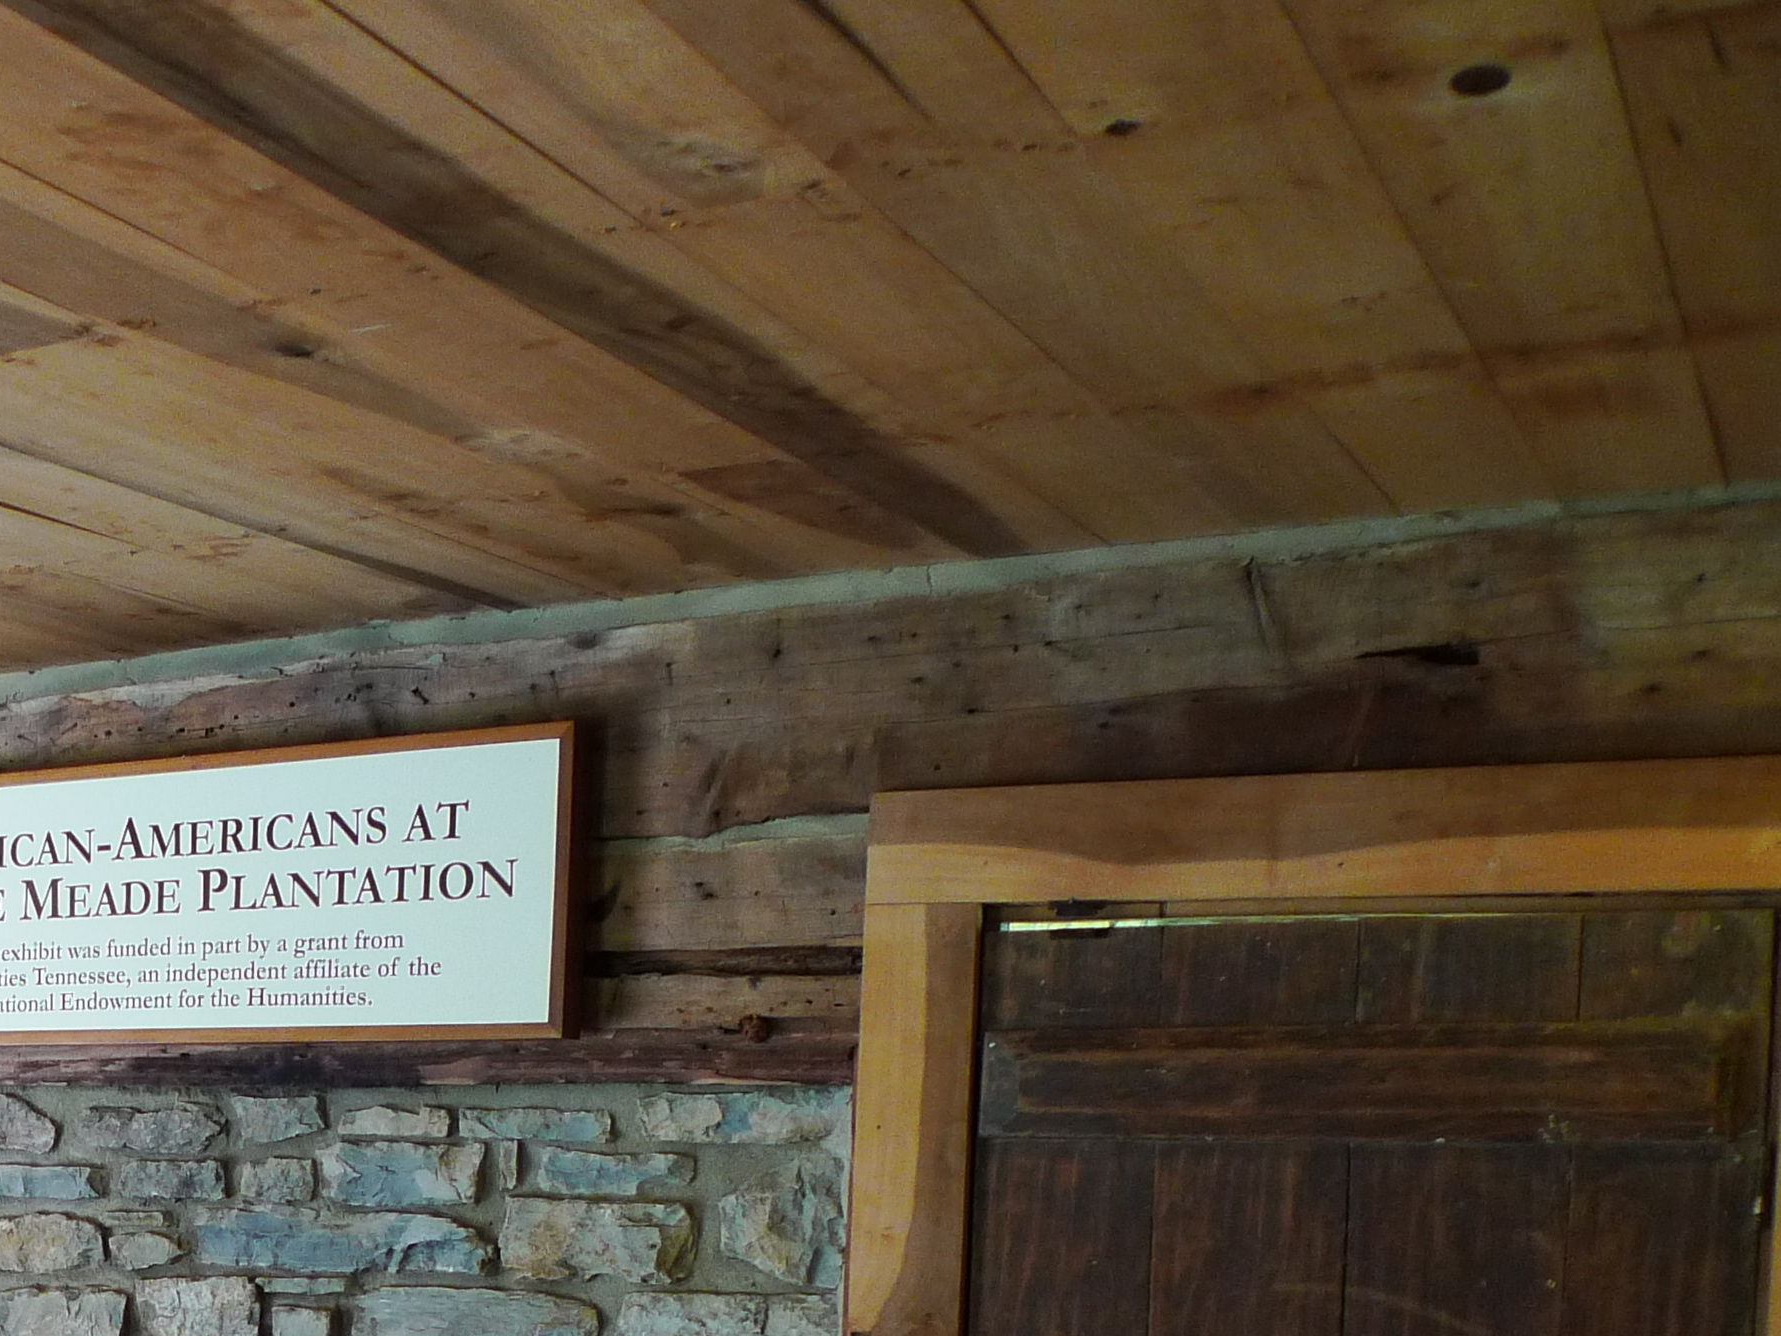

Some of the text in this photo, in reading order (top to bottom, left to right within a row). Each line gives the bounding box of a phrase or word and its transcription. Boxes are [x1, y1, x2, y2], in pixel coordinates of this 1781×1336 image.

[403, 800, 469, 842] AT
[21, 878, 180, 920] MEADE
[198, 859, 518, 911] PLANTATION
[1, 942, 61, 961] exhibit
[68, 946, 100, 959] was
[107, 937, 171, 958] funded
[178, 936, 196, 955] in
[202, 938, 240, 961] part
[248, 934, 270, 960] by
[277, 939, 287, 952] a
[293, 935, 347, 958] grant
[355, 929, 404, 950] from
[166, 960, 286, 988] independent
[293, 959, 371, 979] affiliate
[377, 956, 401, 977] of
[409, 956, 441, 976] the
[33, 968, 131, 986] Tennessee,
[138, 970, 159, 983] an
[61, 991, 171, 1011] Endowment
[179, 989, 204, 1008] for
[211, 988, 240, 1007] the
